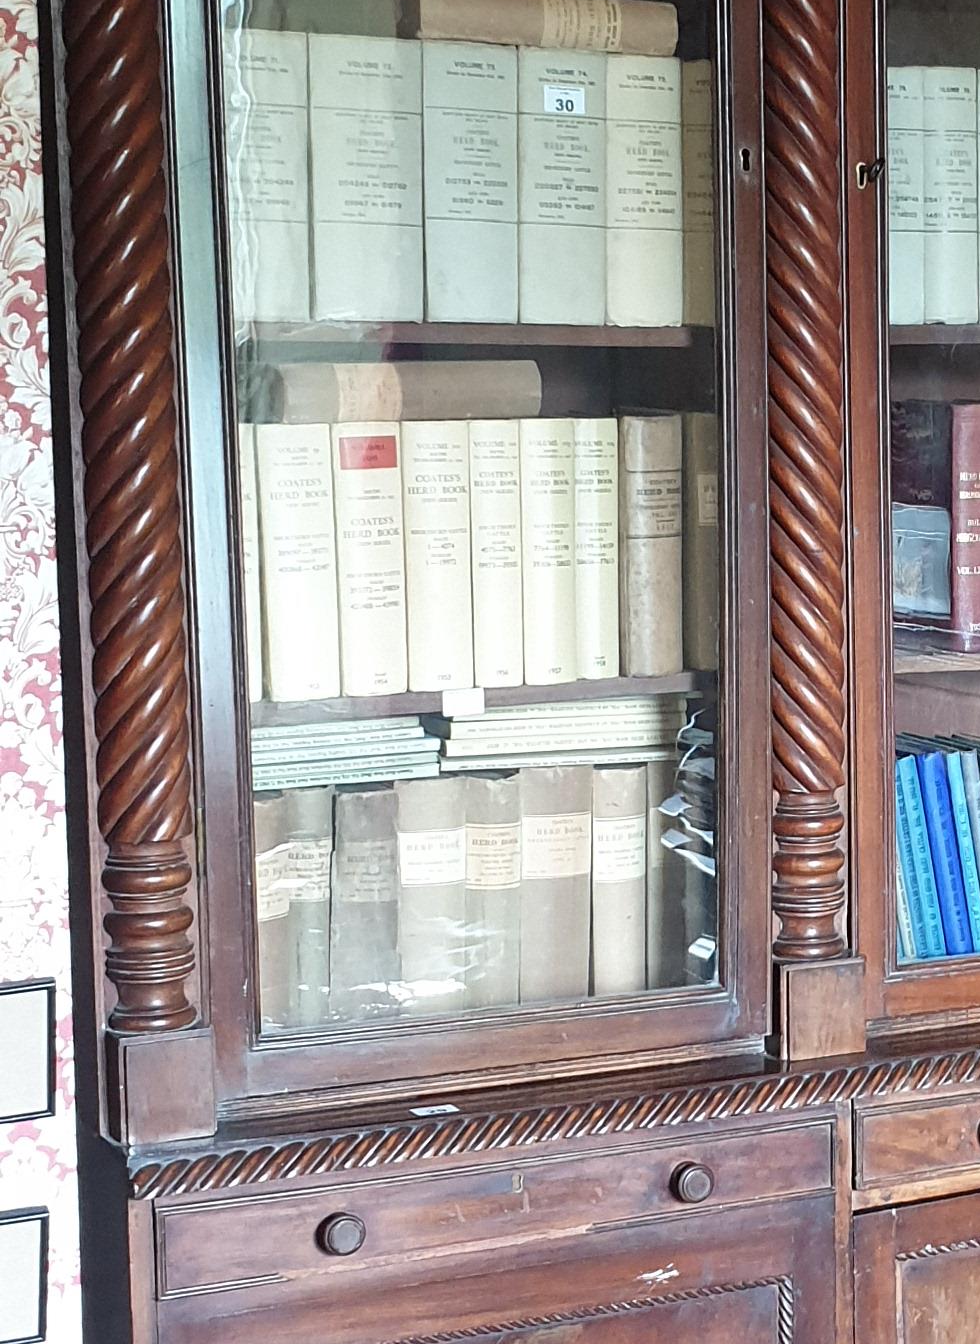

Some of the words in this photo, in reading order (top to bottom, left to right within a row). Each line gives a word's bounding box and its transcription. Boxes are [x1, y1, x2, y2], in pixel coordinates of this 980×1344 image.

[555, 98, 574, 112] 30
[415, 474, 462, 482] COATES'S
[408, 486, 436, 495] HERD
[442, 486, 468, 494] BOOK
